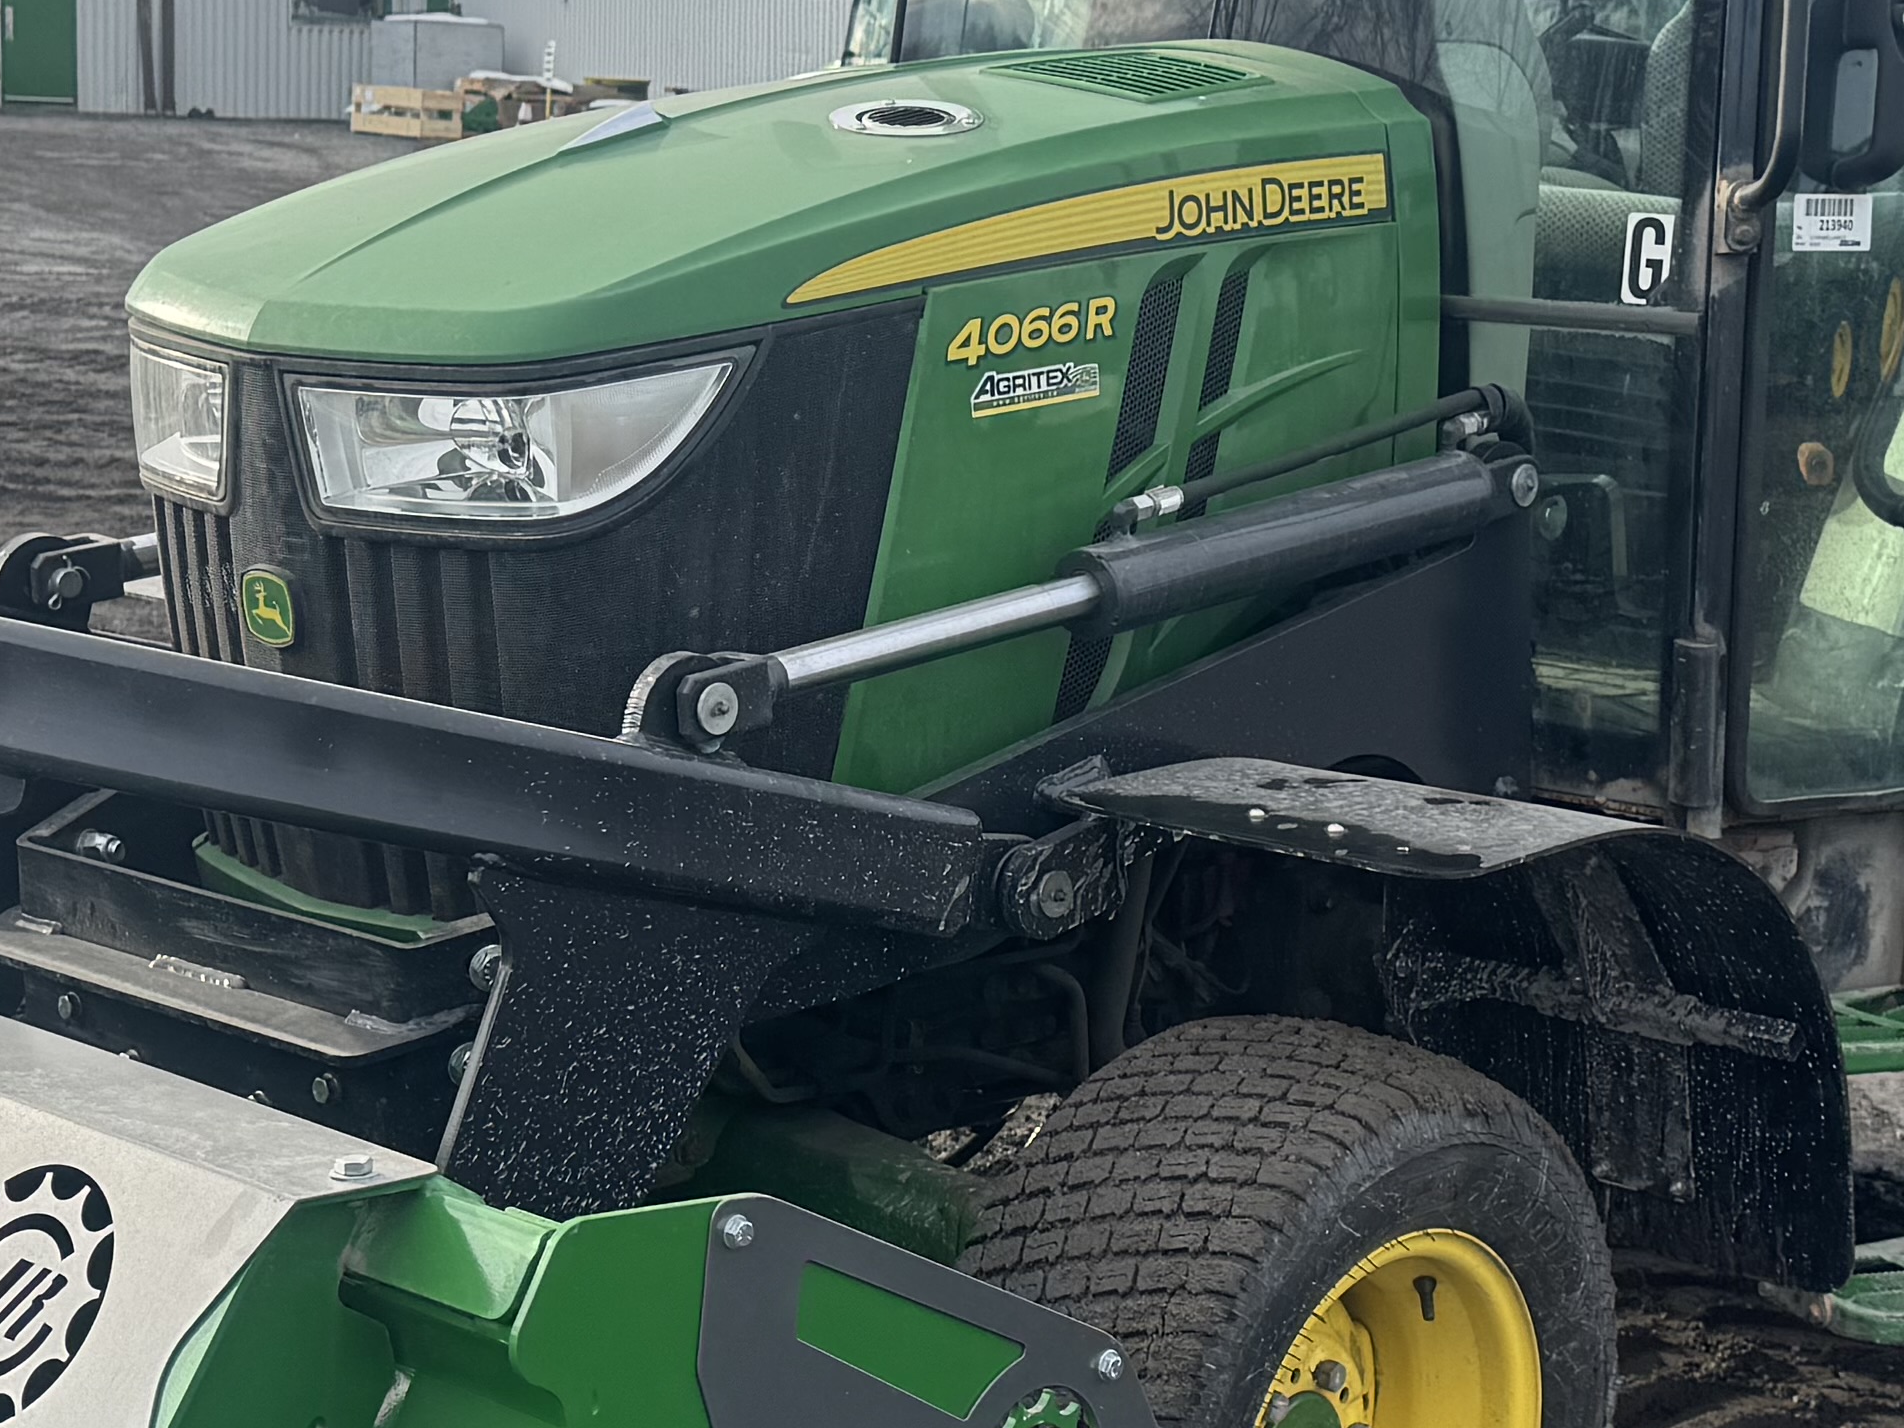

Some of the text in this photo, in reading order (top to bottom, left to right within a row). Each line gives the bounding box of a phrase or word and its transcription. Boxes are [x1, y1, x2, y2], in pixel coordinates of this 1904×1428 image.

[1156, 176, 1365, 234] JOHN DEERE
[1628, 217, 1666, 300] G
[975, 365, 1074, 401] AGRITEX
